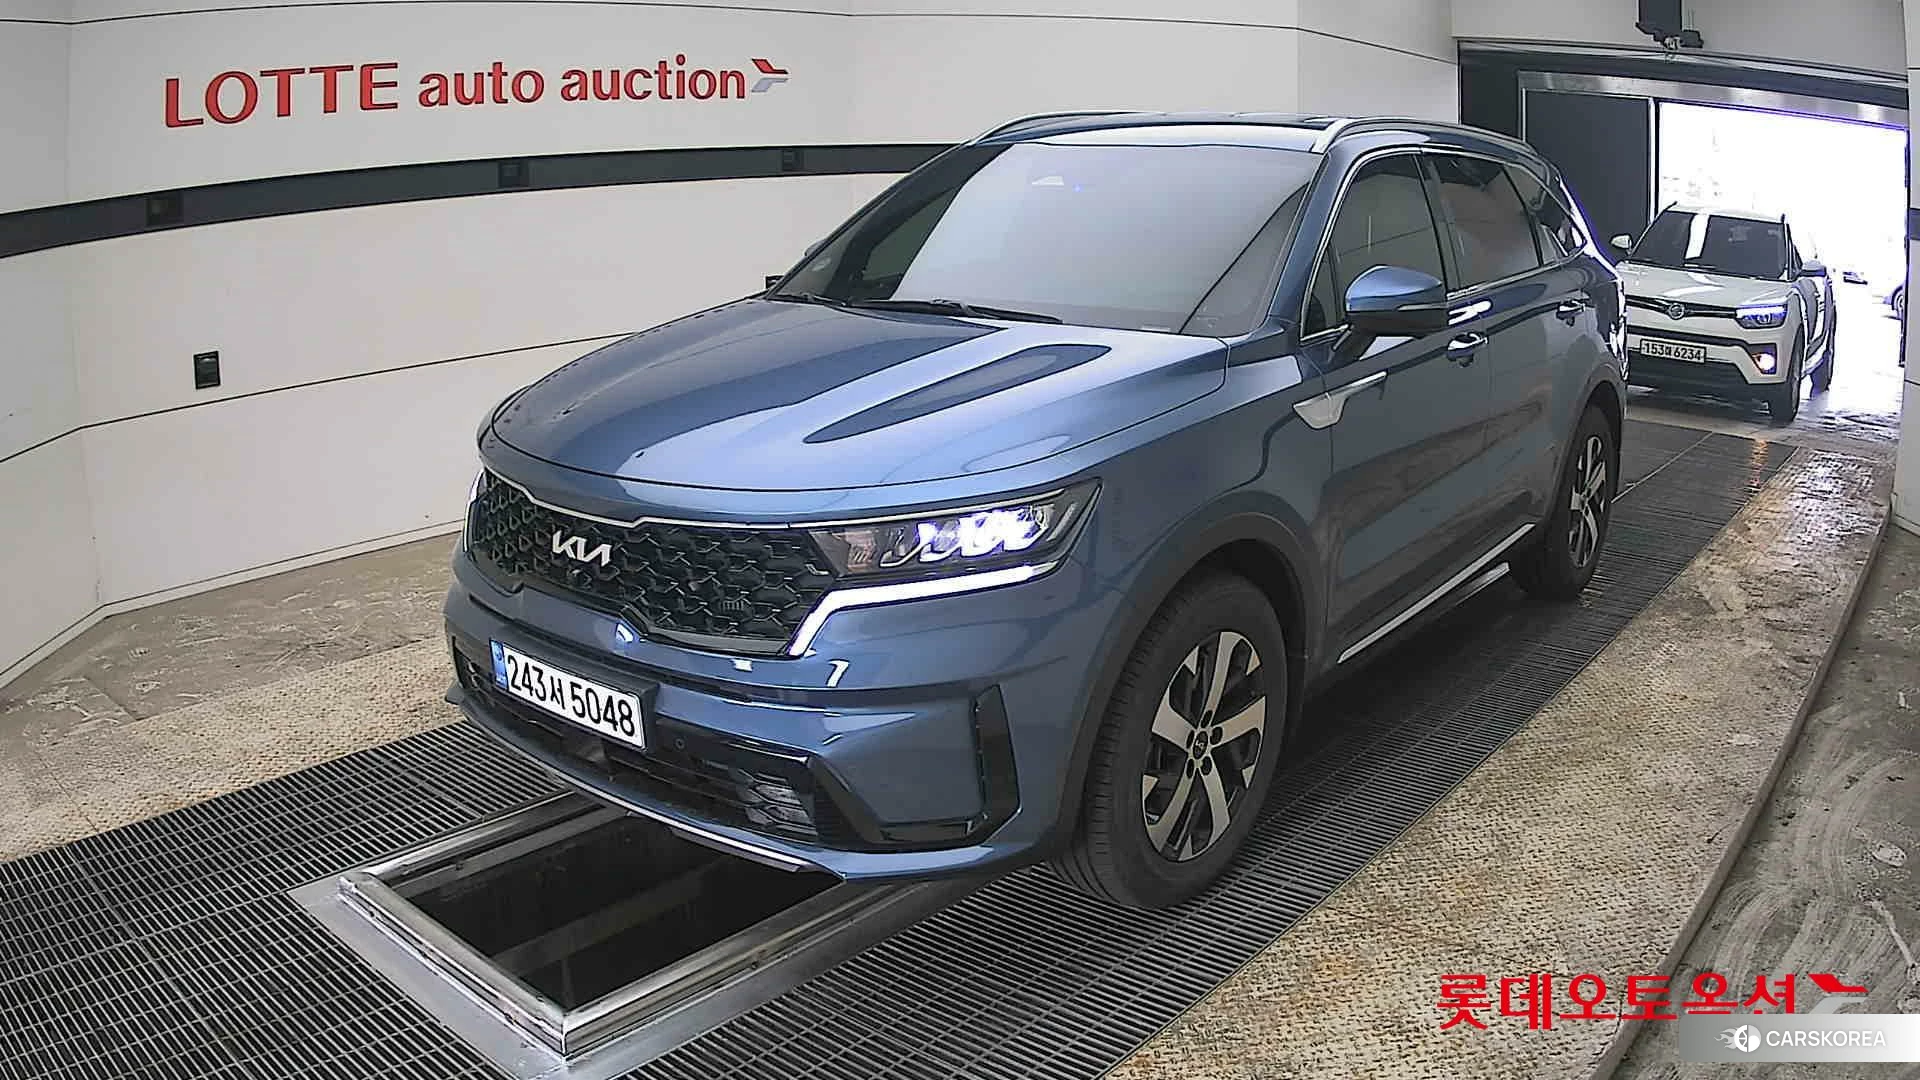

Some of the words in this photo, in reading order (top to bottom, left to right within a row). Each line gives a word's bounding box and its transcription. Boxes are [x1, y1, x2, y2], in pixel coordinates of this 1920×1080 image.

[165, 62, 399, 128] LOTTE
[417, 61, 546, 108] auto
[560, 53, 747, 101] auction
[1673, 346, 1701, 361] 6234
[507, 654, 566, 710] 243서
[569, 681, 635, 737] 5048
